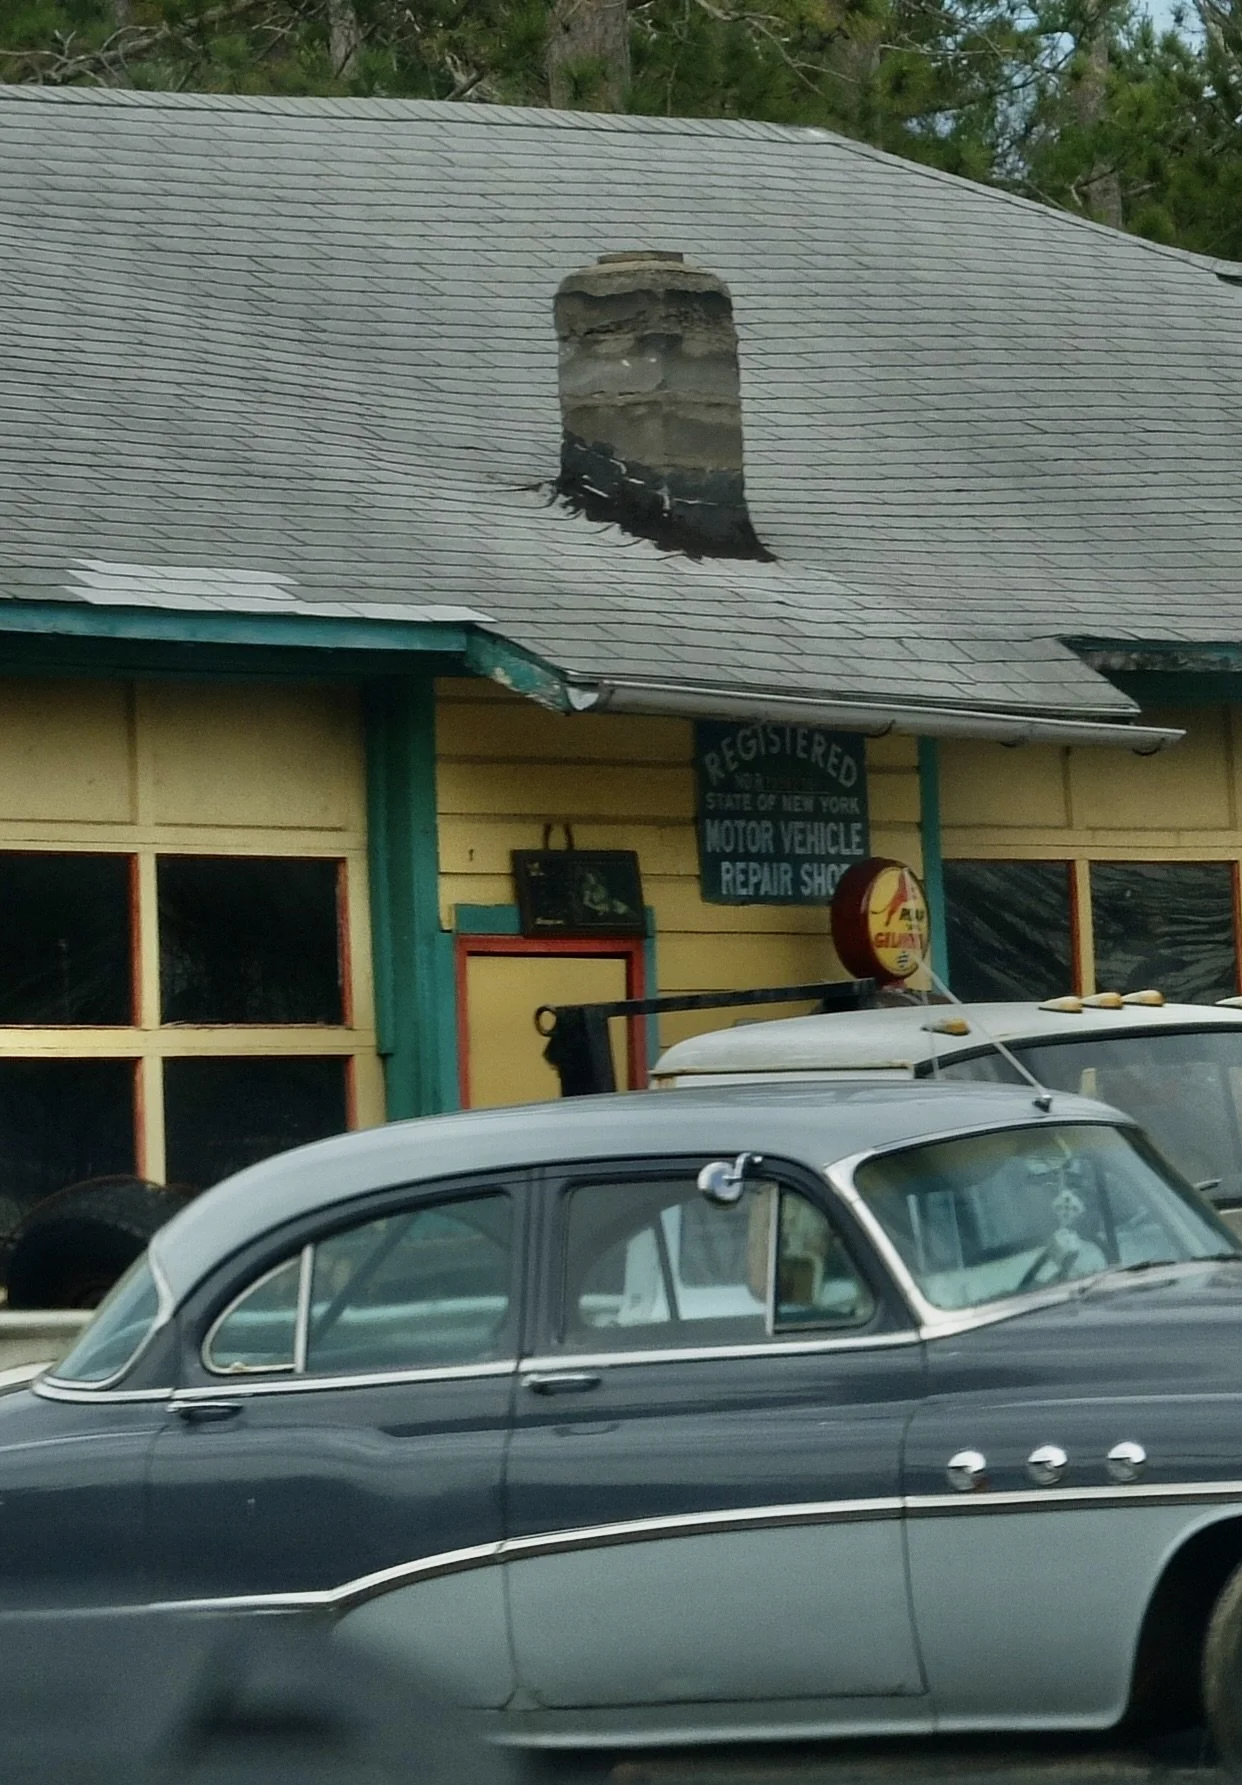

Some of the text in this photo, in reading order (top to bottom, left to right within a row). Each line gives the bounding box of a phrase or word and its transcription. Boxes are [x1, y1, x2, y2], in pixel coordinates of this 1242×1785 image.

[704, 722, 858, 788] REGISTERED
[705, 793, 861, 814] STATE OF NEW YORK
[704, 819, 864, 856] MOTOR VEHICLE
[720, 861, 852, 897] REPAIR SHO
